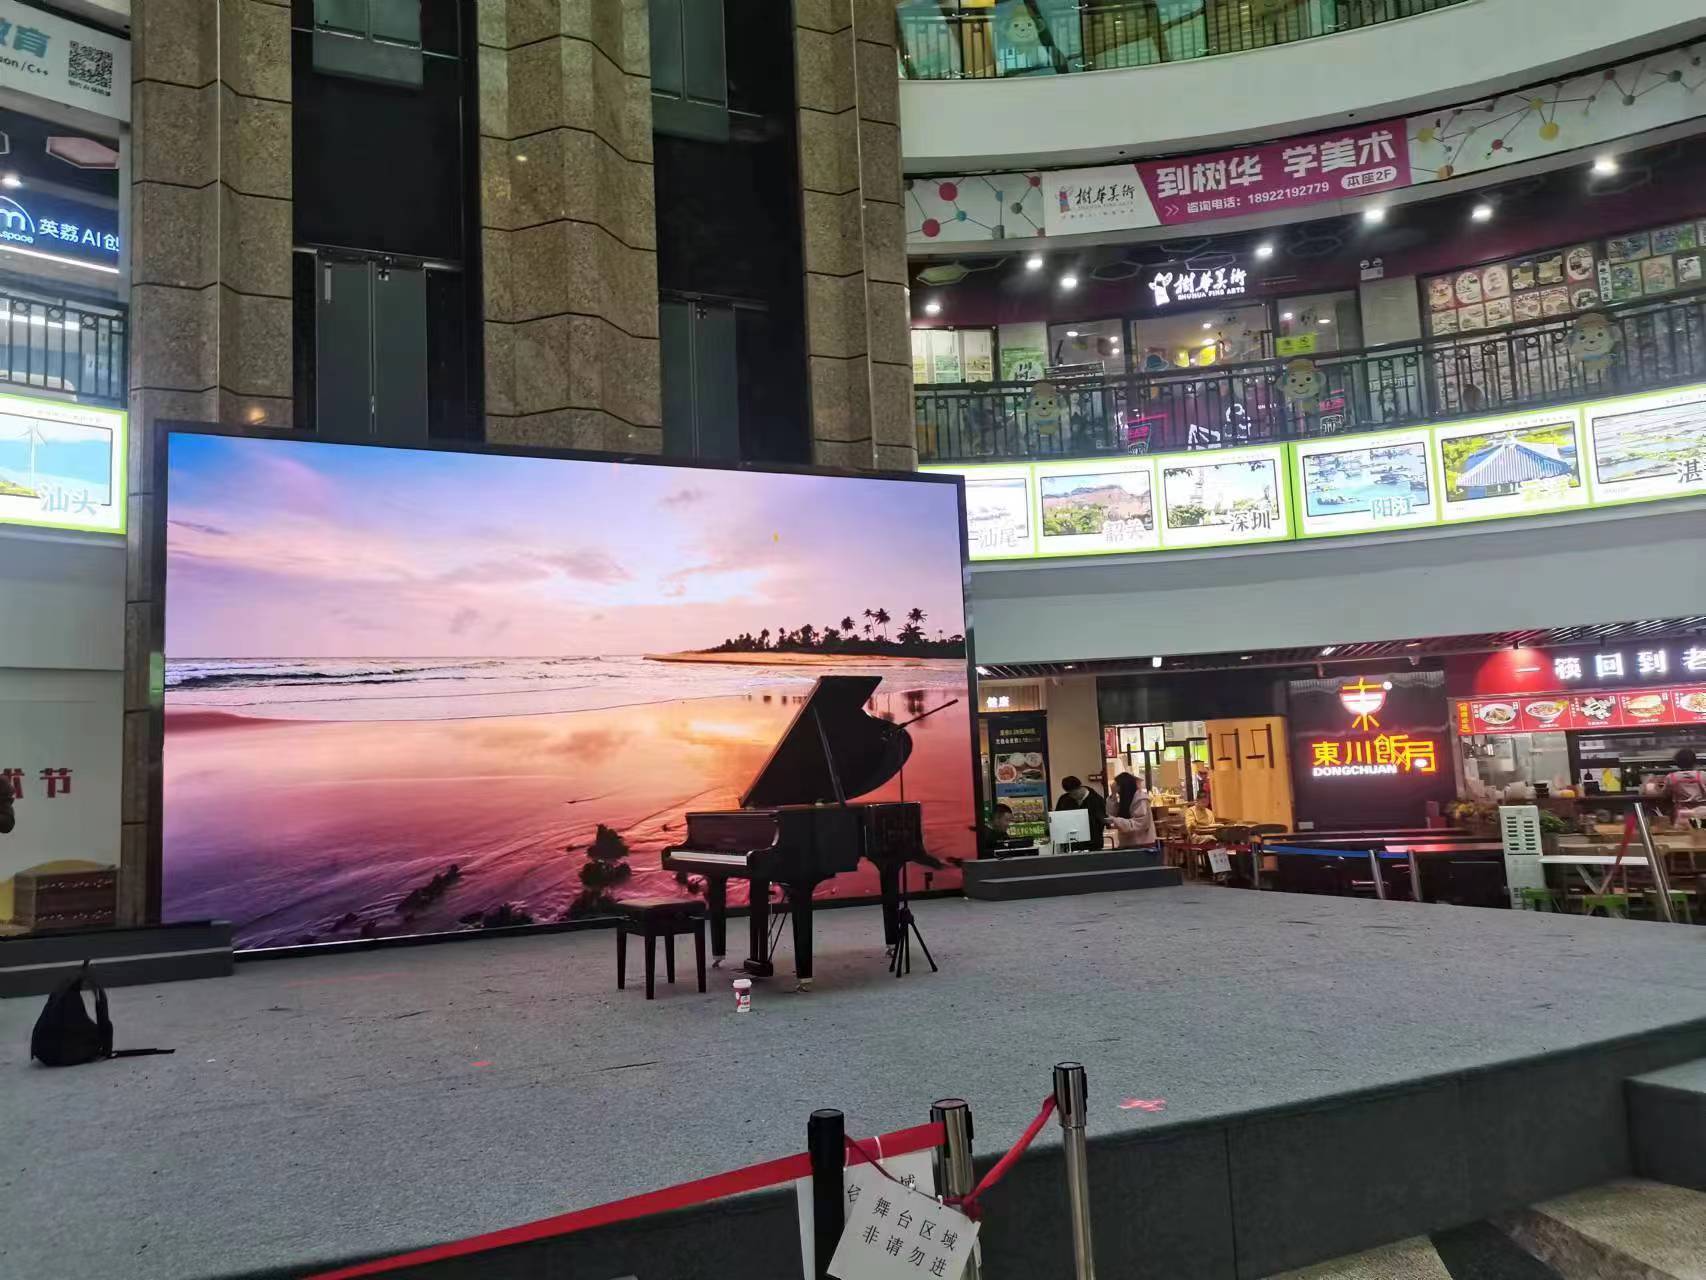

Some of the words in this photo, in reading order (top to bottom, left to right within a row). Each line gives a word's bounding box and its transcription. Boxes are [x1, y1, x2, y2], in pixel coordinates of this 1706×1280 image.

[1156, 154, 1263, 199] 到树华
[1281, 130, 1396, 179] 学美术
[1346, 168, 1392, 188] 本座2F
[1677, 458, 1706, 484] 湛
[40, 484, 98, 516] 汕头
[1371, 496, 1417, 520] 阳江
[1229, 509, 1271, 533] 深圳
[978, 527, 1018, 549] 汕尾
[1312, 764, 1398, 777] DONGCHUAN
[872, 1197, 958, 1252] 舞台区域
[862, 1225, 947, 1278] 非请勿进
